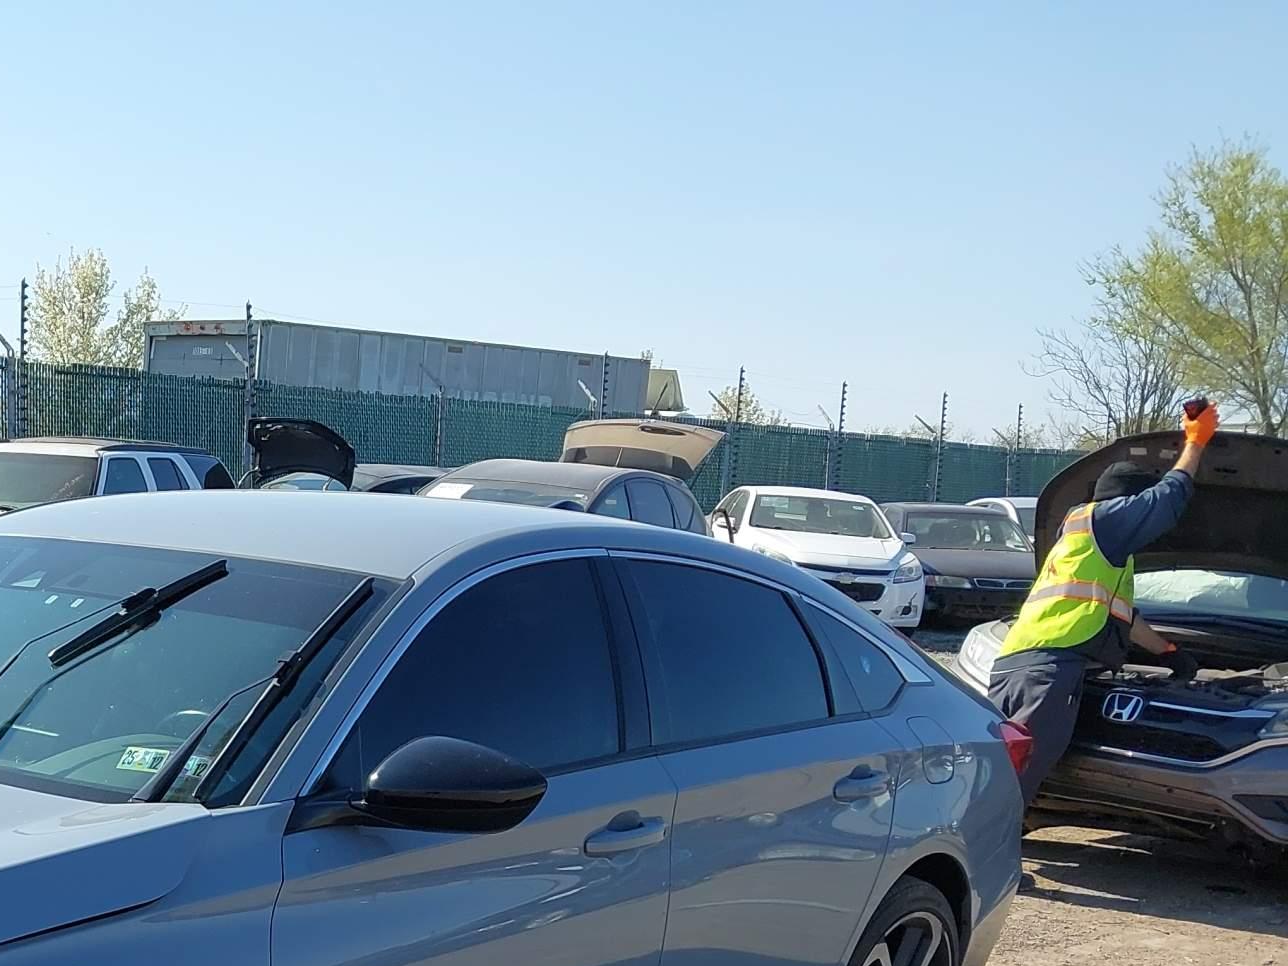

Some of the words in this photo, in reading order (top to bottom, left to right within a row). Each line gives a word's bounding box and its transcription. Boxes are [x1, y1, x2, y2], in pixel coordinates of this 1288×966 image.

[121, 750, 136, 765] 25
[149, 755, 163, 769] 12
[192, 762, 208, 776] 12
